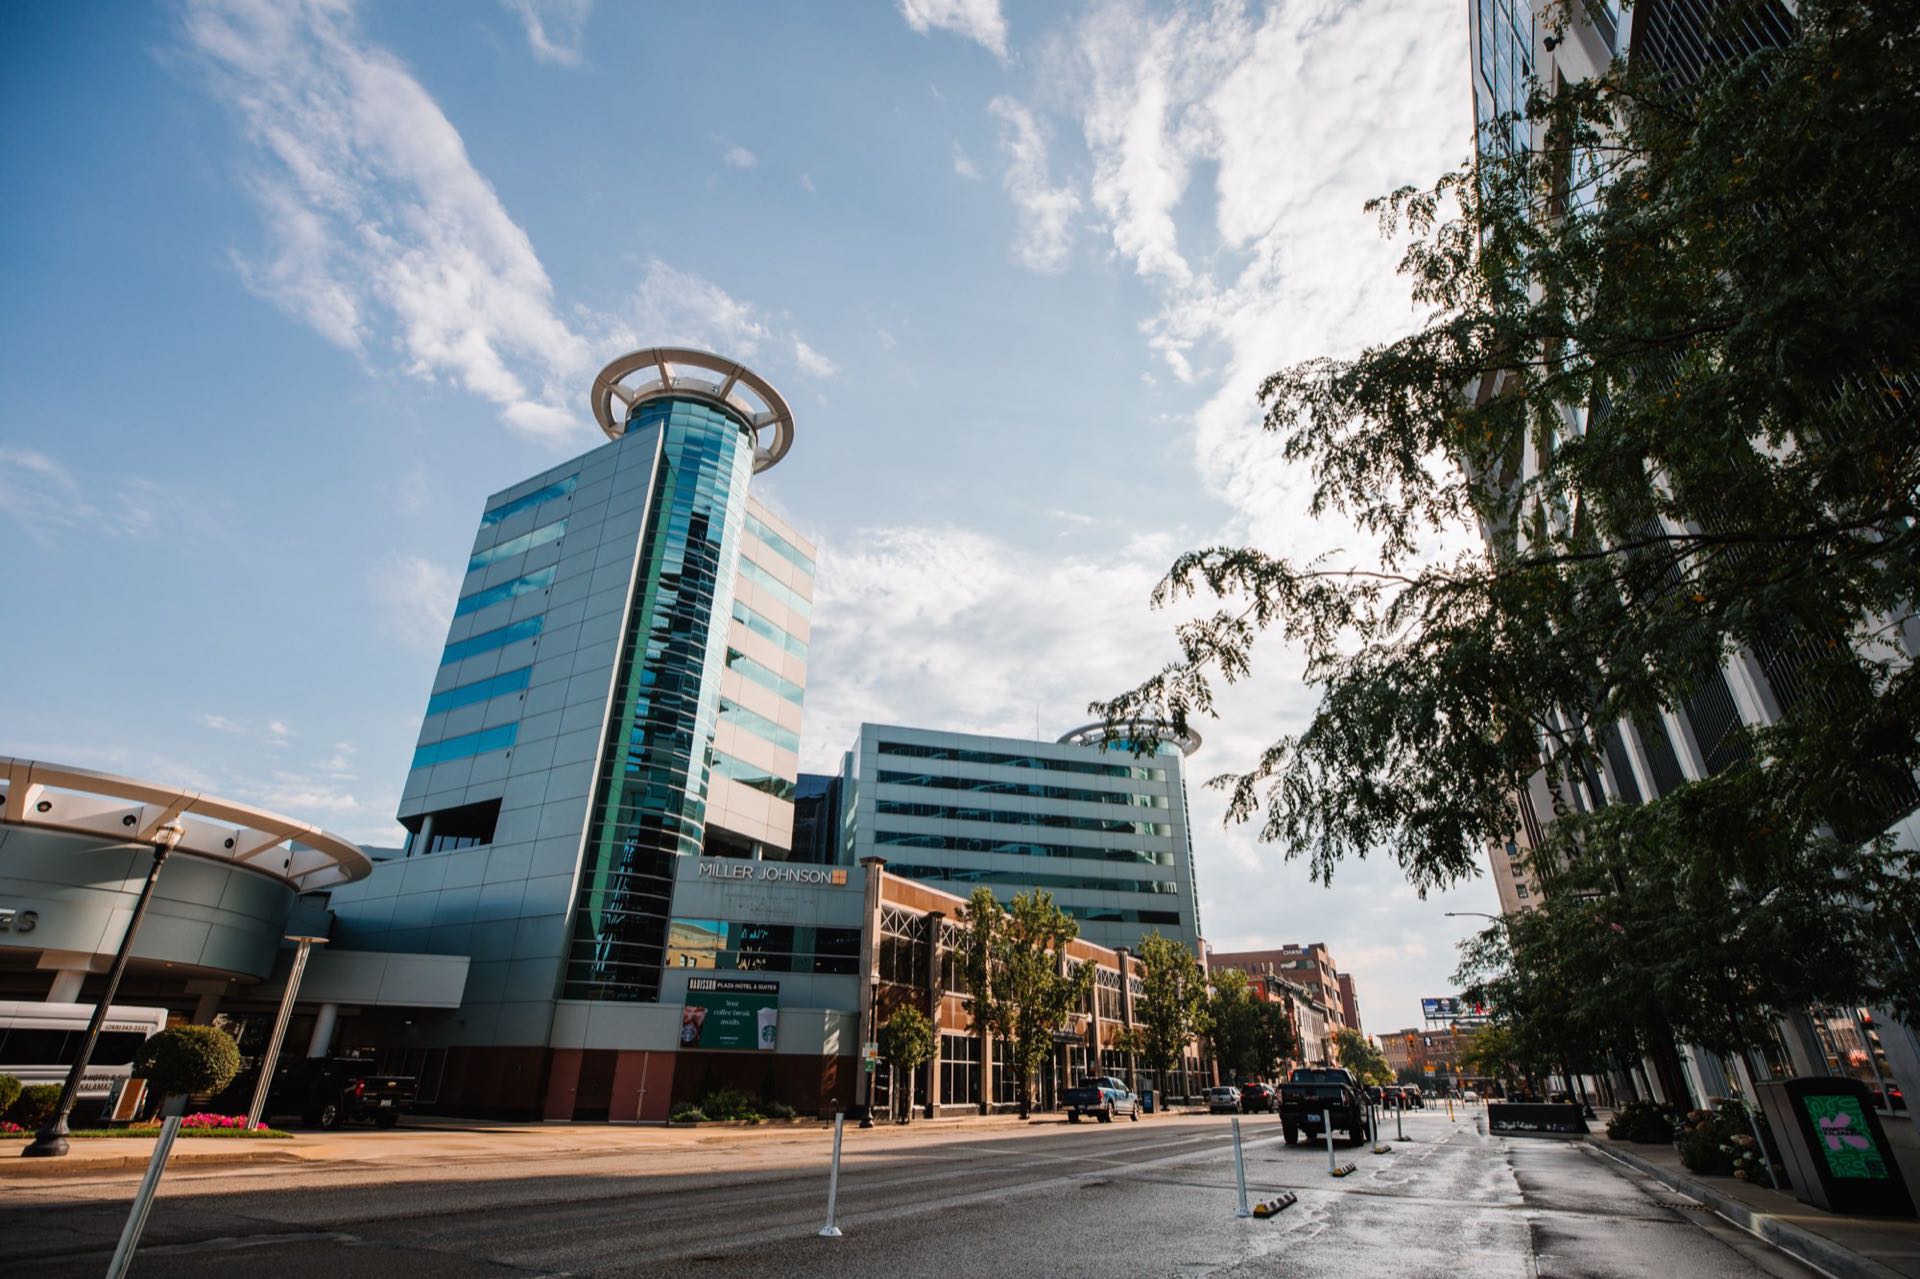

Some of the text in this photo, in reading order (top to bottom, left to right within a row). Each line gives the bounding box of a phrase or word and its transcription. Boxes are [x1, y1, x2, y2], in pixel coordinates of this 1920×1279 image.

[699, 862, 832, 884] MILLER JOHNSON
[689, 979, 717, 990] RADISSON
